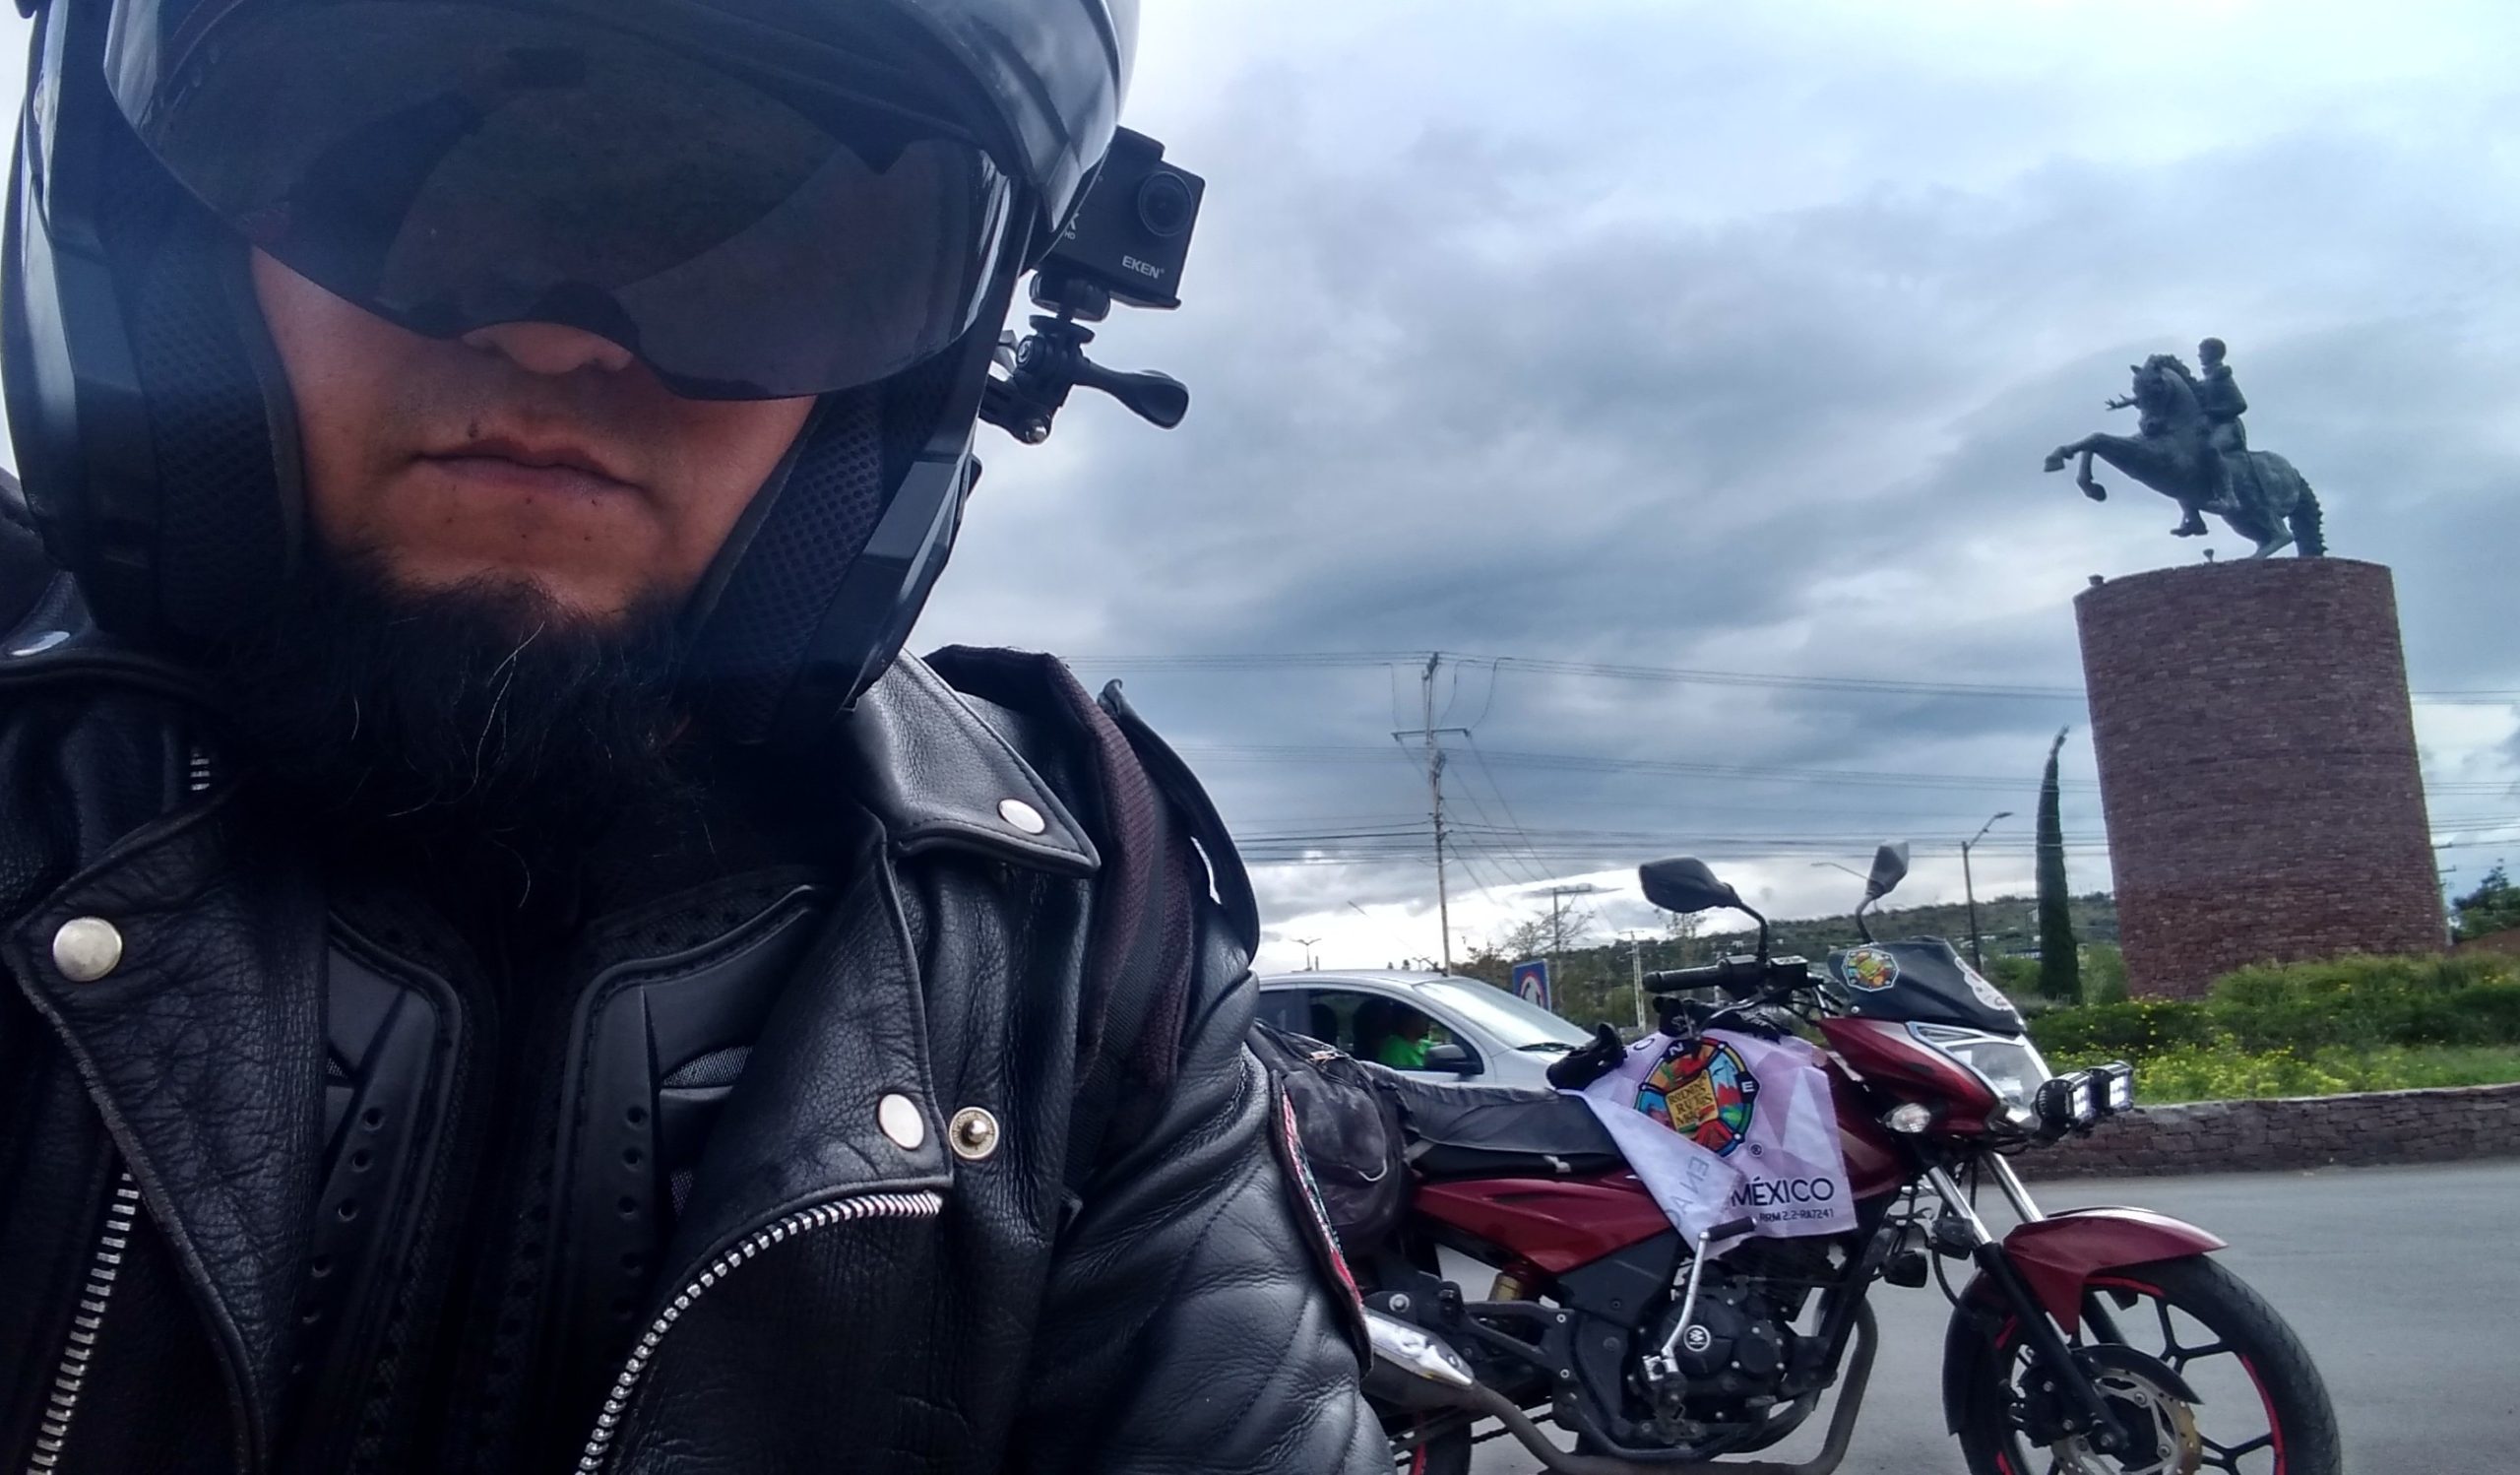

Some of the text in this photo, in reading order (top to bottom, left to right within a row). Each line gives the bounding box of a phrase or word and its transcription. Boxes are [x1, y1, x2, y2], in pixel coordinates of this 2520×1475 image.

[1121, 254, 1160, 280] EKEN
[1741, 1080, 1756, 1093] E
[1730, 1175, 1835, 1208] MÉXICO
